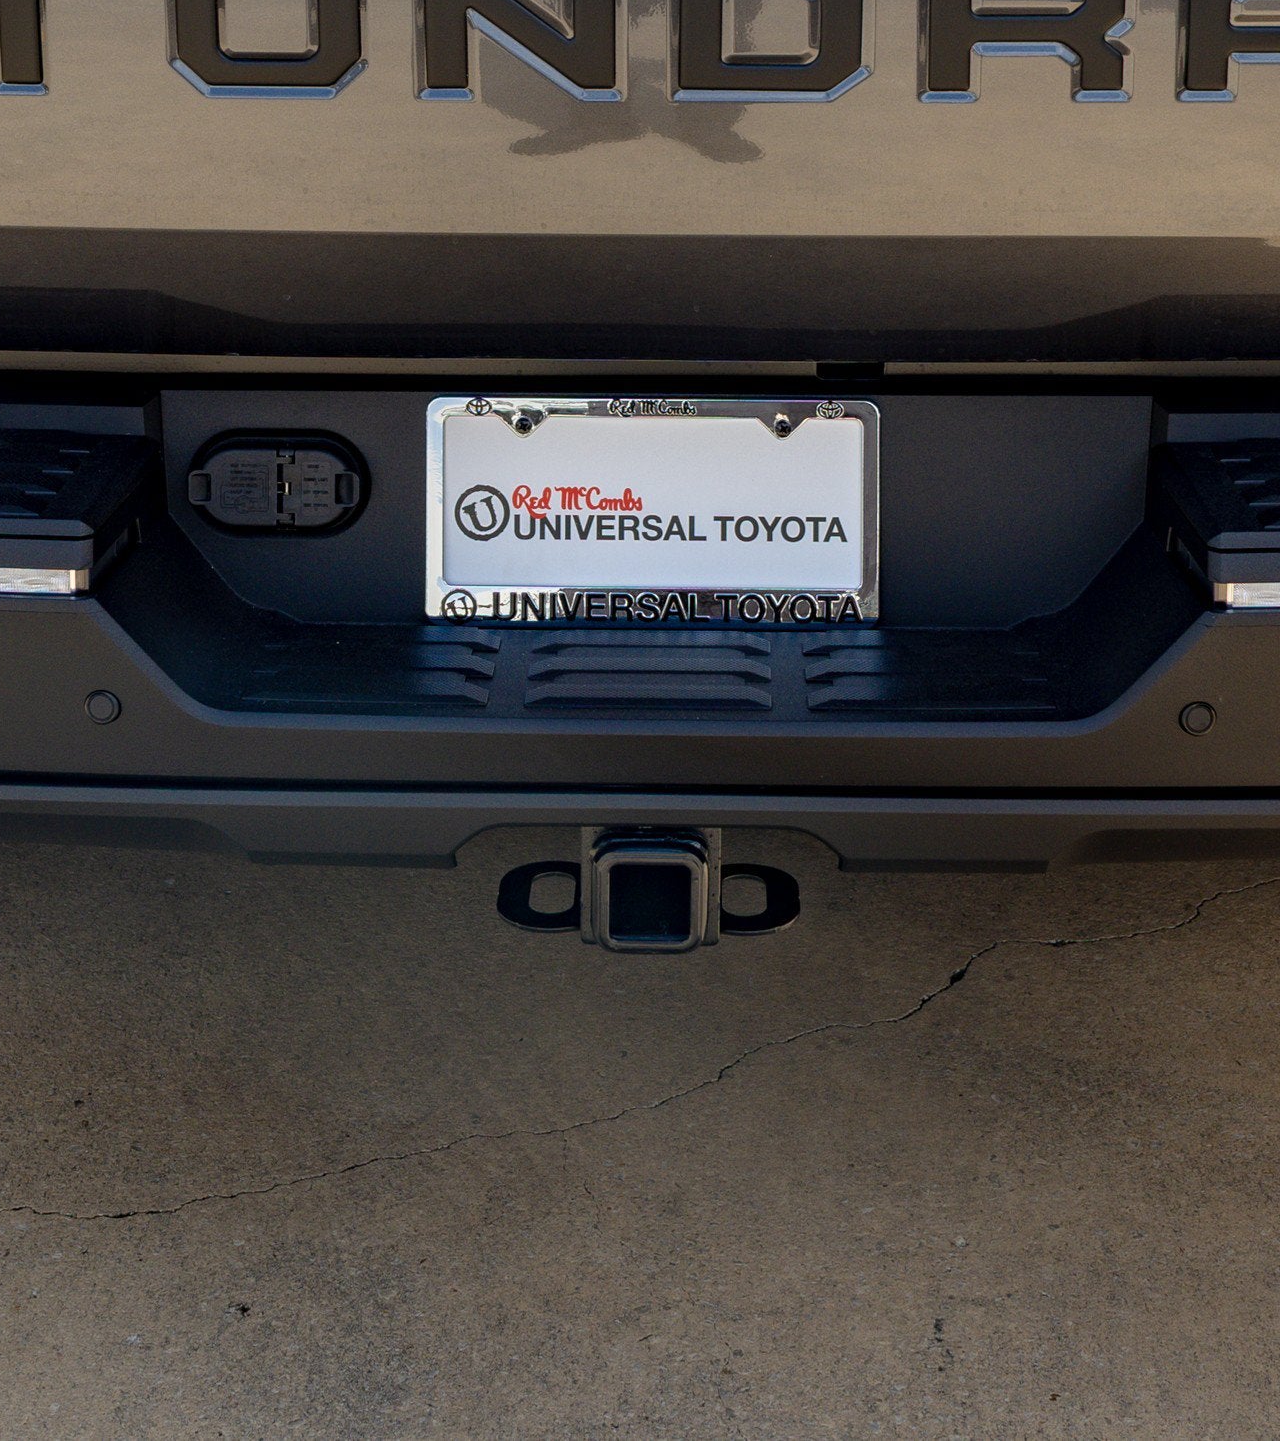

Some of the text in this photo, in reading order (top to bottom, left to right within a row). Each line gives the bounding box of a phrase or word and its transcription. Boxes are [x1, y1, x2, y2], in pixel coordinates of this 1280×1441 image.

[607, 399, 636, 417] Red
[512, 484, 643, 519] Red McCombs
[513, 514, 848, 543] UNIVERSAL TOYOTA
[491, 591, 864, 624] UNIVERSAL TOYOTA
